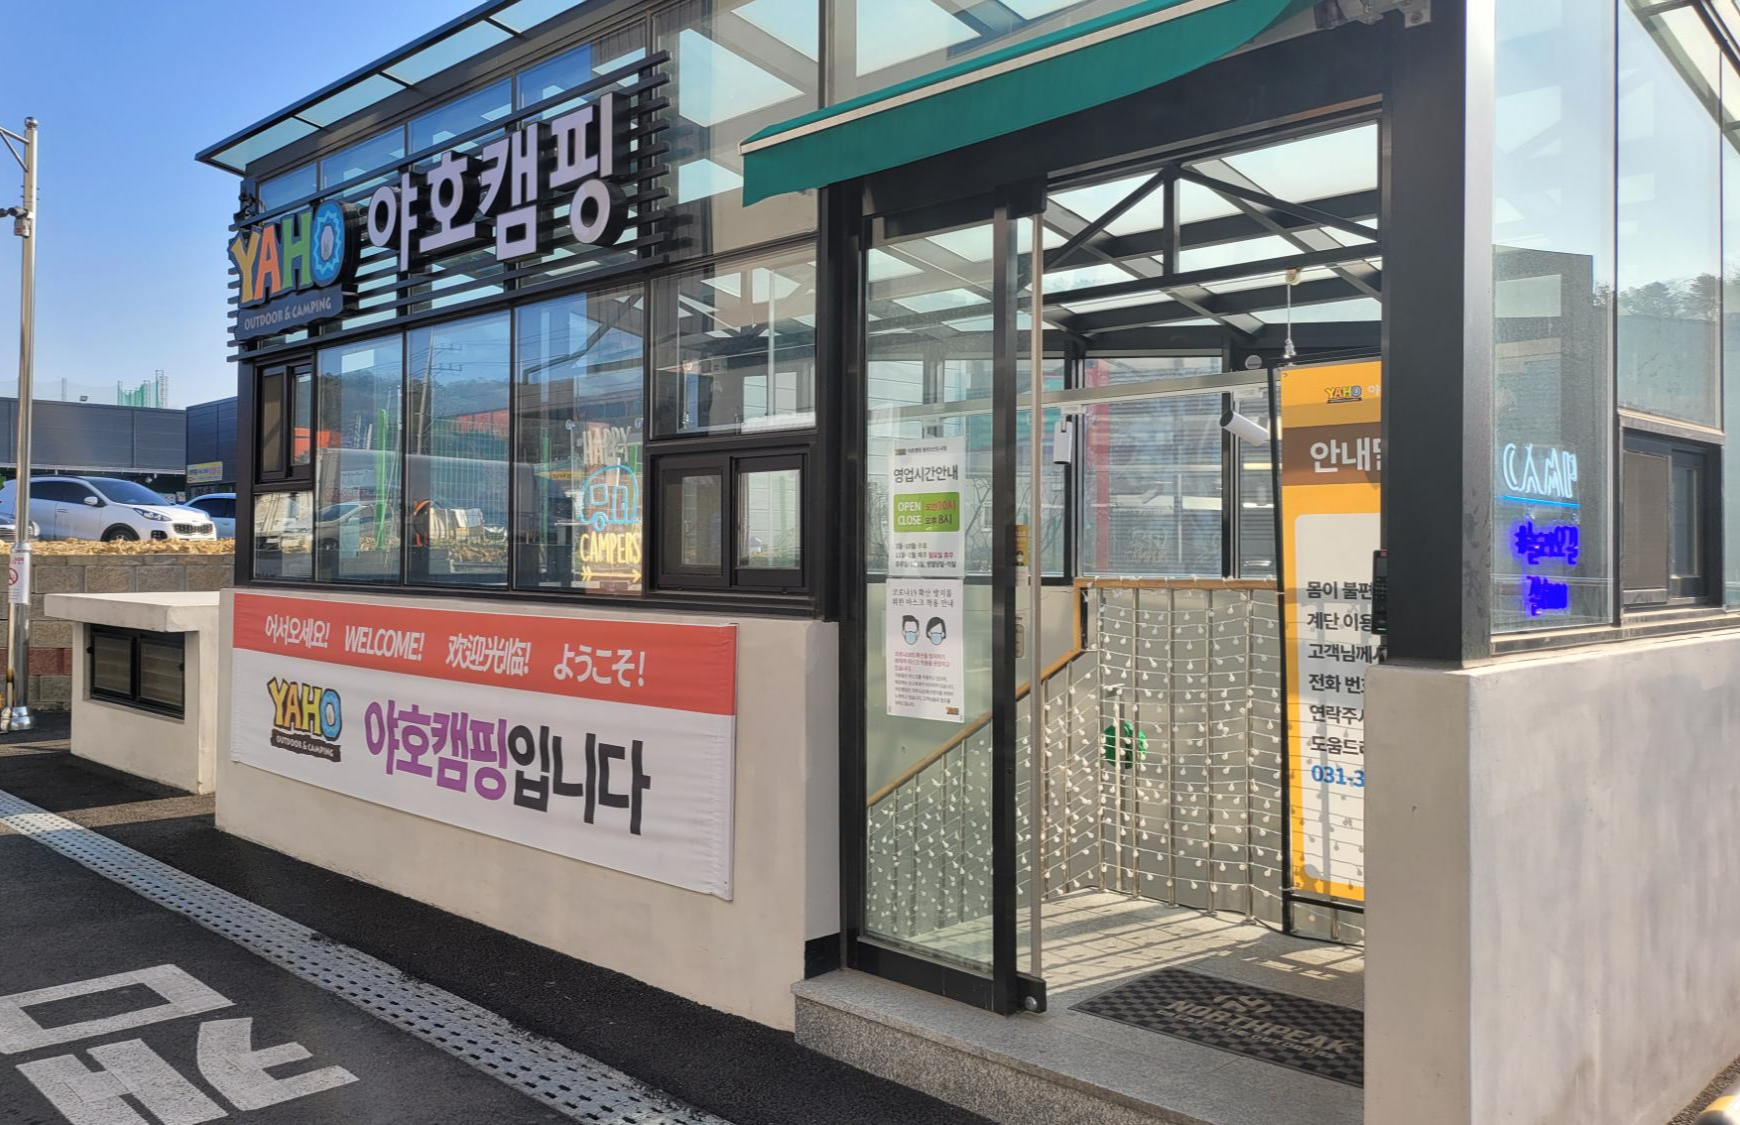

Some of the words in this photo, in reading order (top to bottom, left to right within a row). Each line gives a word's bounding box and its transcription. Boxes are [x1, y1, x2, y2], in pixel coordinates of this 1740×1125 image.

[368, 92, 613, 271] 야호캠핑
[230, 201, 345, 304] YAHO
[244, 310, 283, 330] OUTDOOR
[284, 306, 291, 319] &
[291, 297, 331, 318] CAMPING
[1325, 386, 1362, 399] YAHO
[582, 426, 631, 465] HAPPY
[894, 464, 958, 483] 영업시간안내
[1503, 442, 1577, 498] CAMP
[898, 502, 921, 511] OPEN
[898, 515, 921, 525] CLOSE
[580, 532, 641, 565] CAMPERS
[1306, 581, 1338, 600] 몸이
[265, 614, 330, 648] 어서오세요!
[1306, 612, 1340, 630] 계단
[345, 625, 425, 661] WELCOME!
[446, 634, 531, 676] 欢迎光临!
[553, 643, 645, 687] ようこそ!
[1308, 673, 1341, 693] 전화
[267, 677, 342, 741] YAHO
[276, 735, 301, 749] OUTDOOR
[308, 743, 334, 757] CAMPING
[364, 699, 651, 836] 야호캠핑입니다
[1311, 765, 1365, 787] 031-3
[1167, 1000, 1355, 1054] NORTHPEAK
